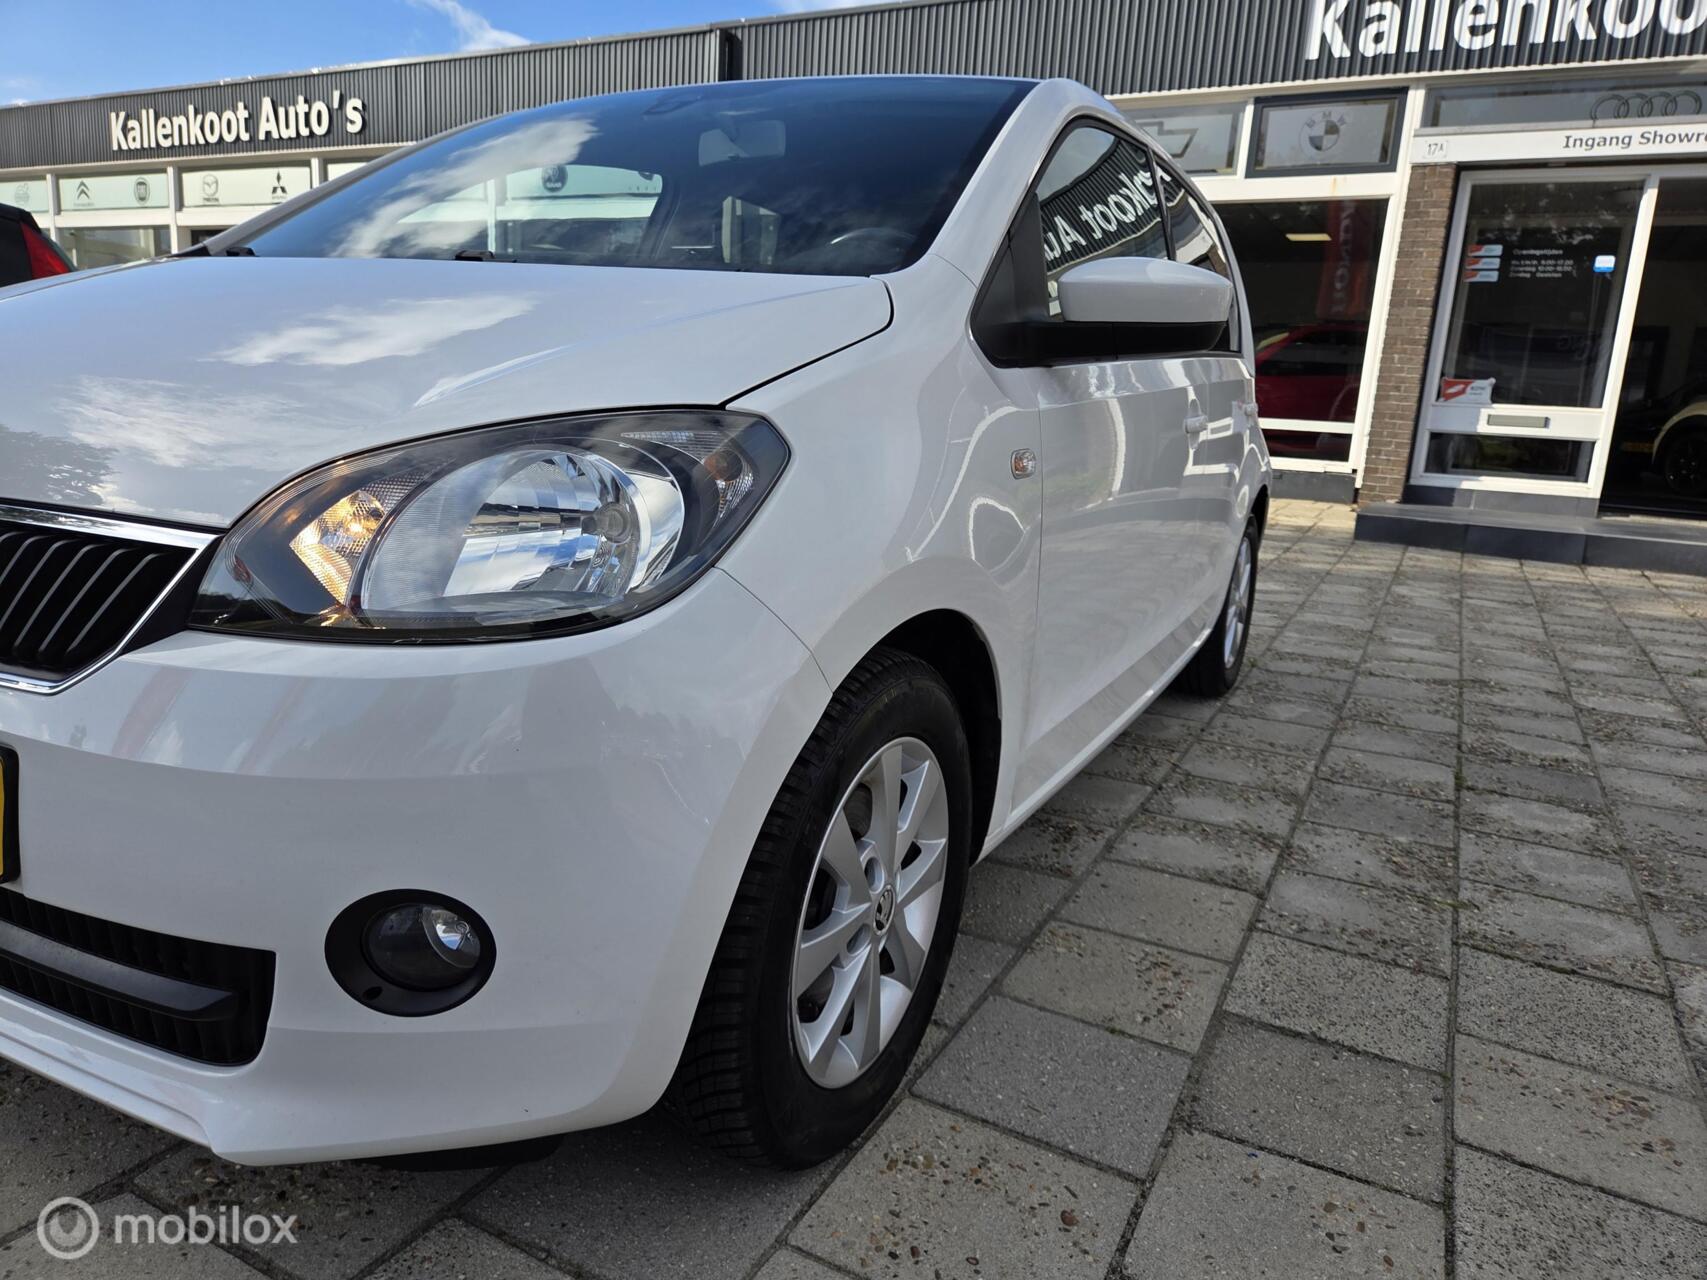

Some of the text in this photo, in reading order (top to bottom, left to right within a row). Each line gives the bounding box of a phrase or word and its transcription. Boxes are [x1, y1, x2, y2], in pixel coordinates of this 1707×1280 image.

[110, 89, 365, 151] Kallenkoot Auto's
[1562, 130, 1707, 151] Ingang Showr
